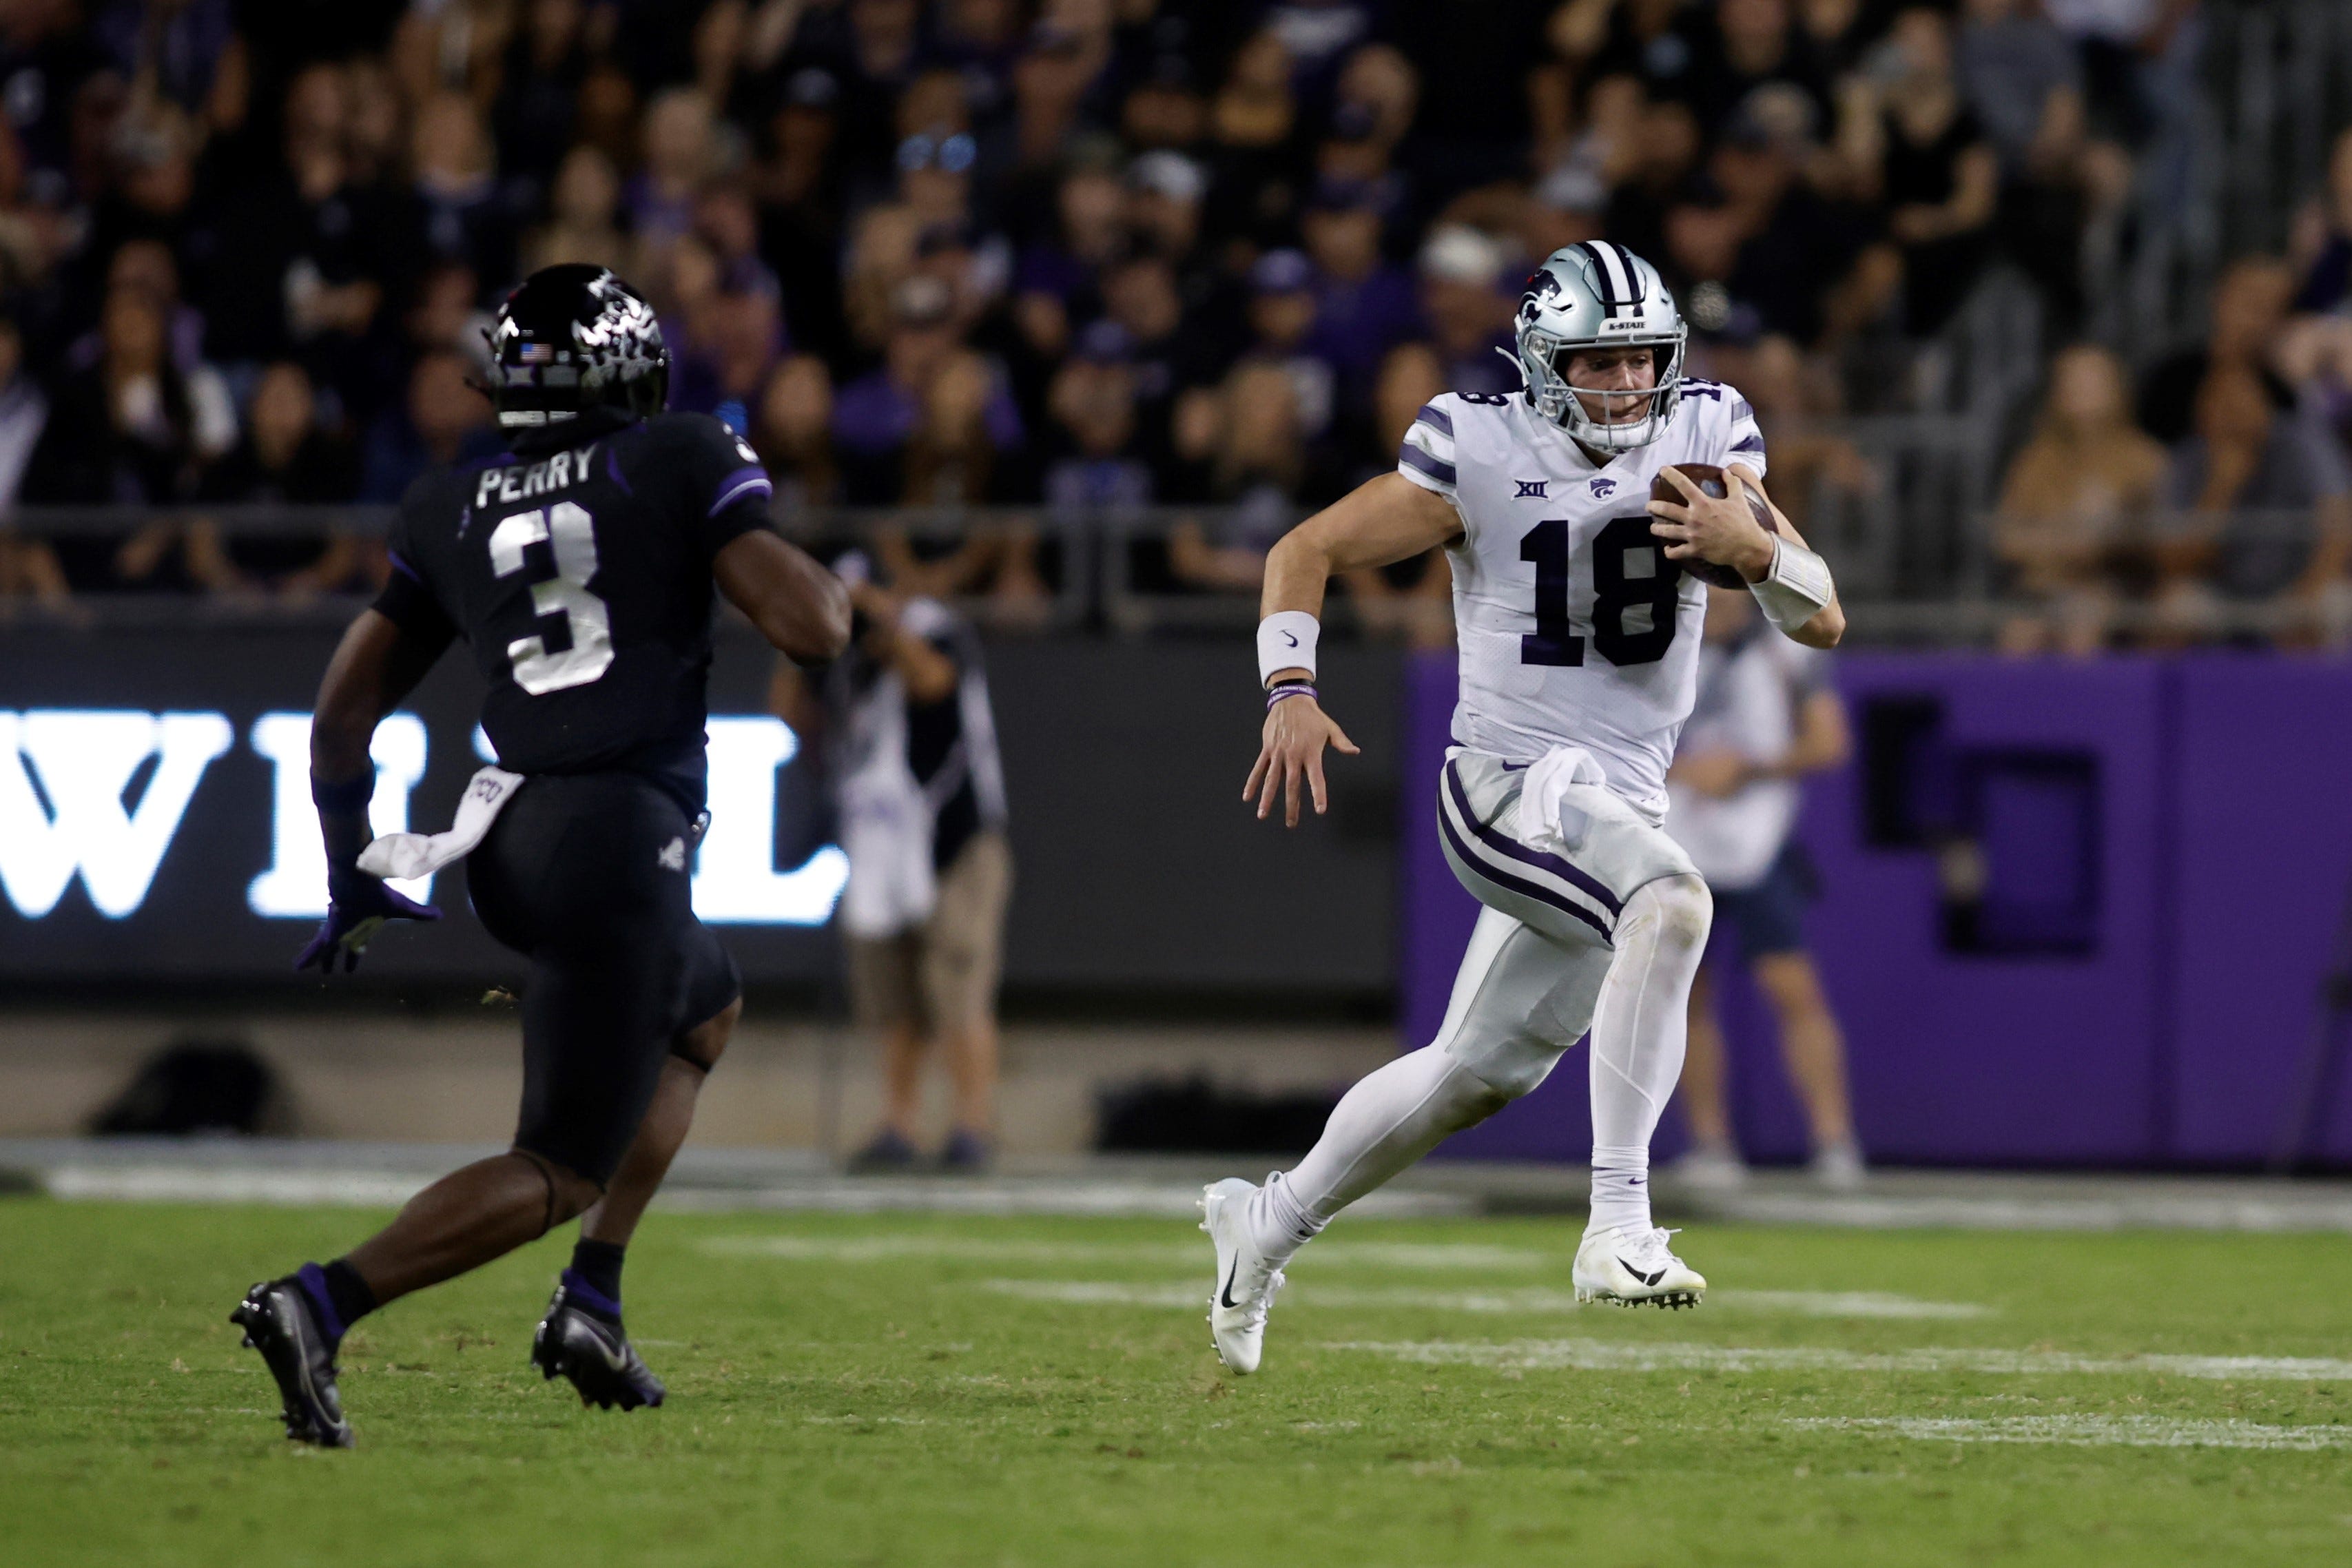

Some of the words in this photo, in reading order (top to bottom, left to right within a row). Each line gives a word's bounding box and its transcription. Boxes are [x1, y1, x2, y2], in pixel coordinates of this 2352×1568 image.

[1609, 322, 1647, 330] K-STATE
[475, 442, 599, 509] PERRY
[1514, 479, 1549, 499] XII
[488, 501, 615, 697] 3
[1520, 516, 1683, 667] 18
